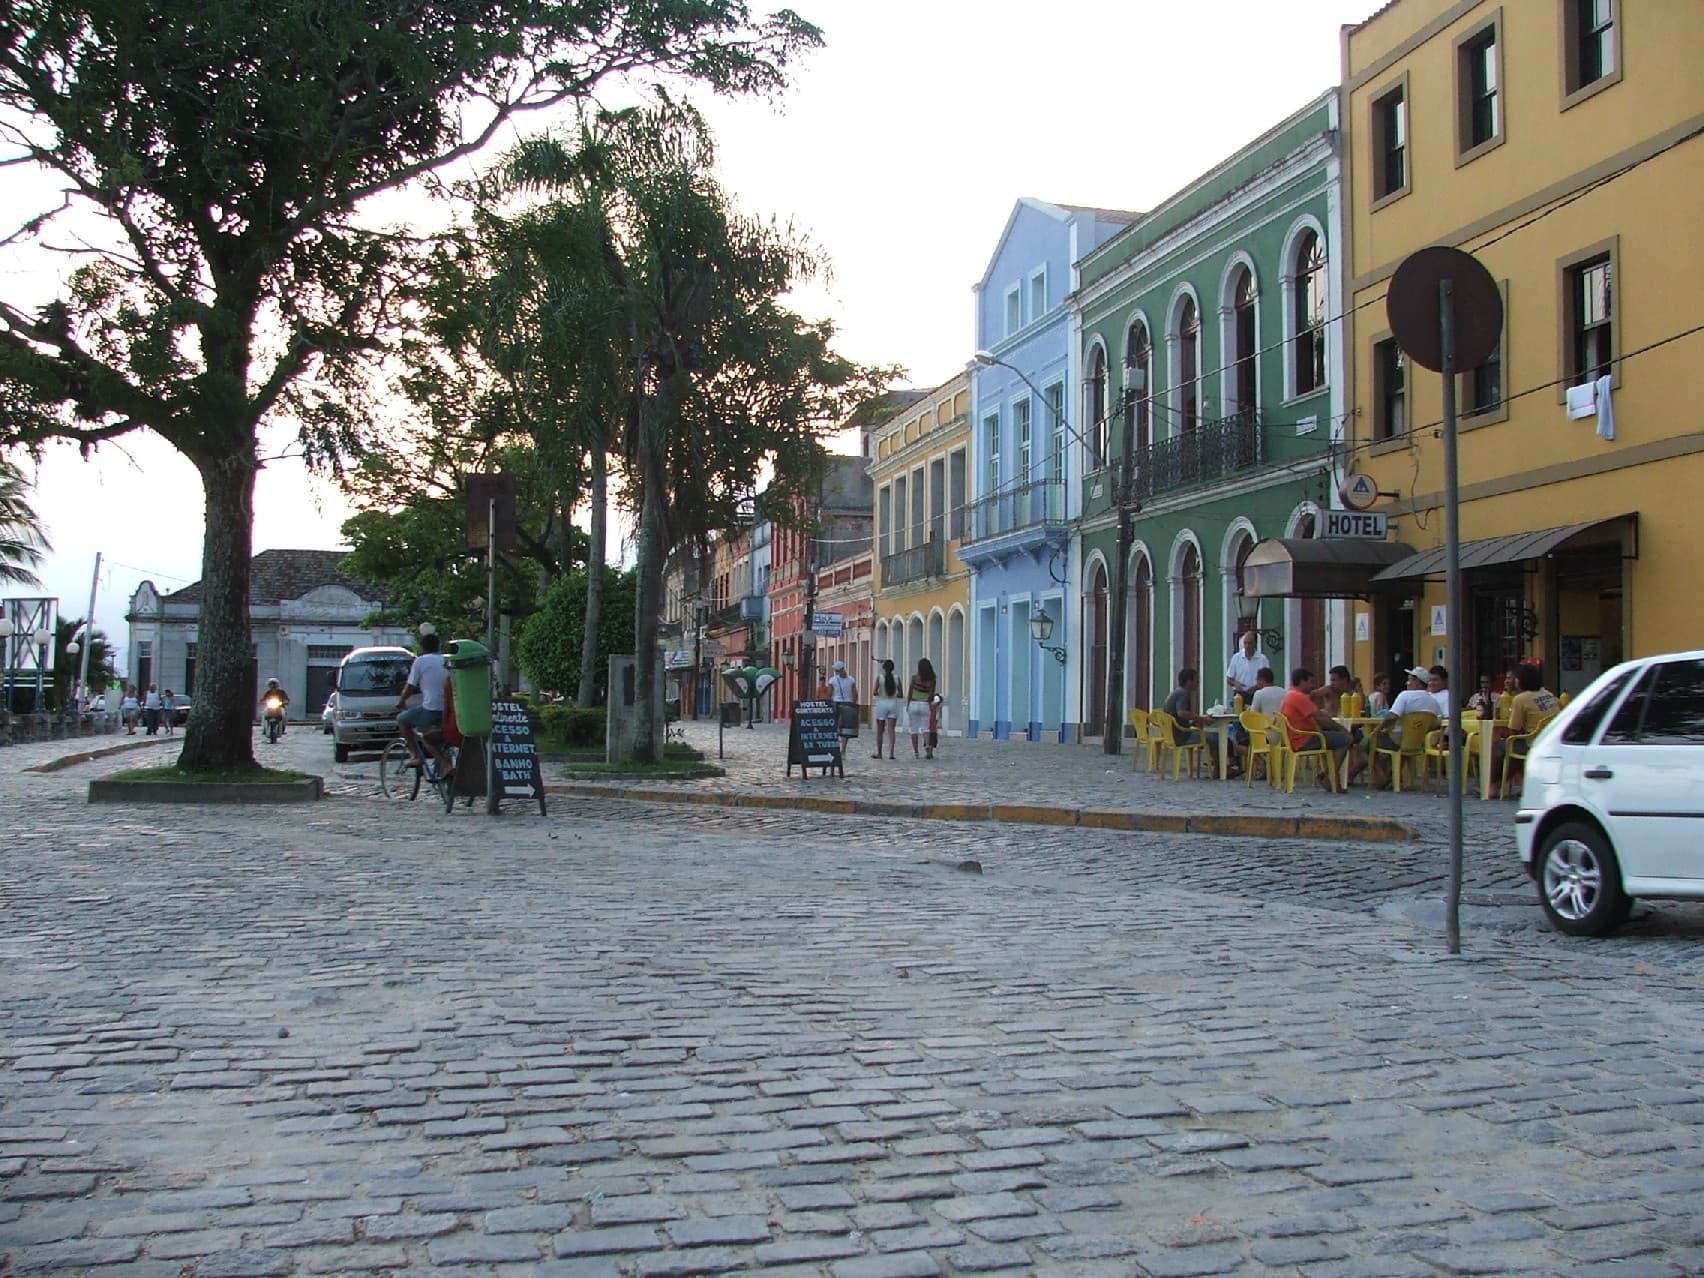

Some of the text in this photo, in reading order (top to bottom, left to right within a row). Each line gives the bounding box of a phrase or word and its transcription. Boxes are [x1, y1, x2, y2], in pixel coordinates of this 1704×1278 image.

[1328, 515, 1382, 536] HOTEL
[800, 719, 835, 727] ACESSO
[491, 725, 530, 735] CESSO
[494, 758, 533, 769] BANHO
